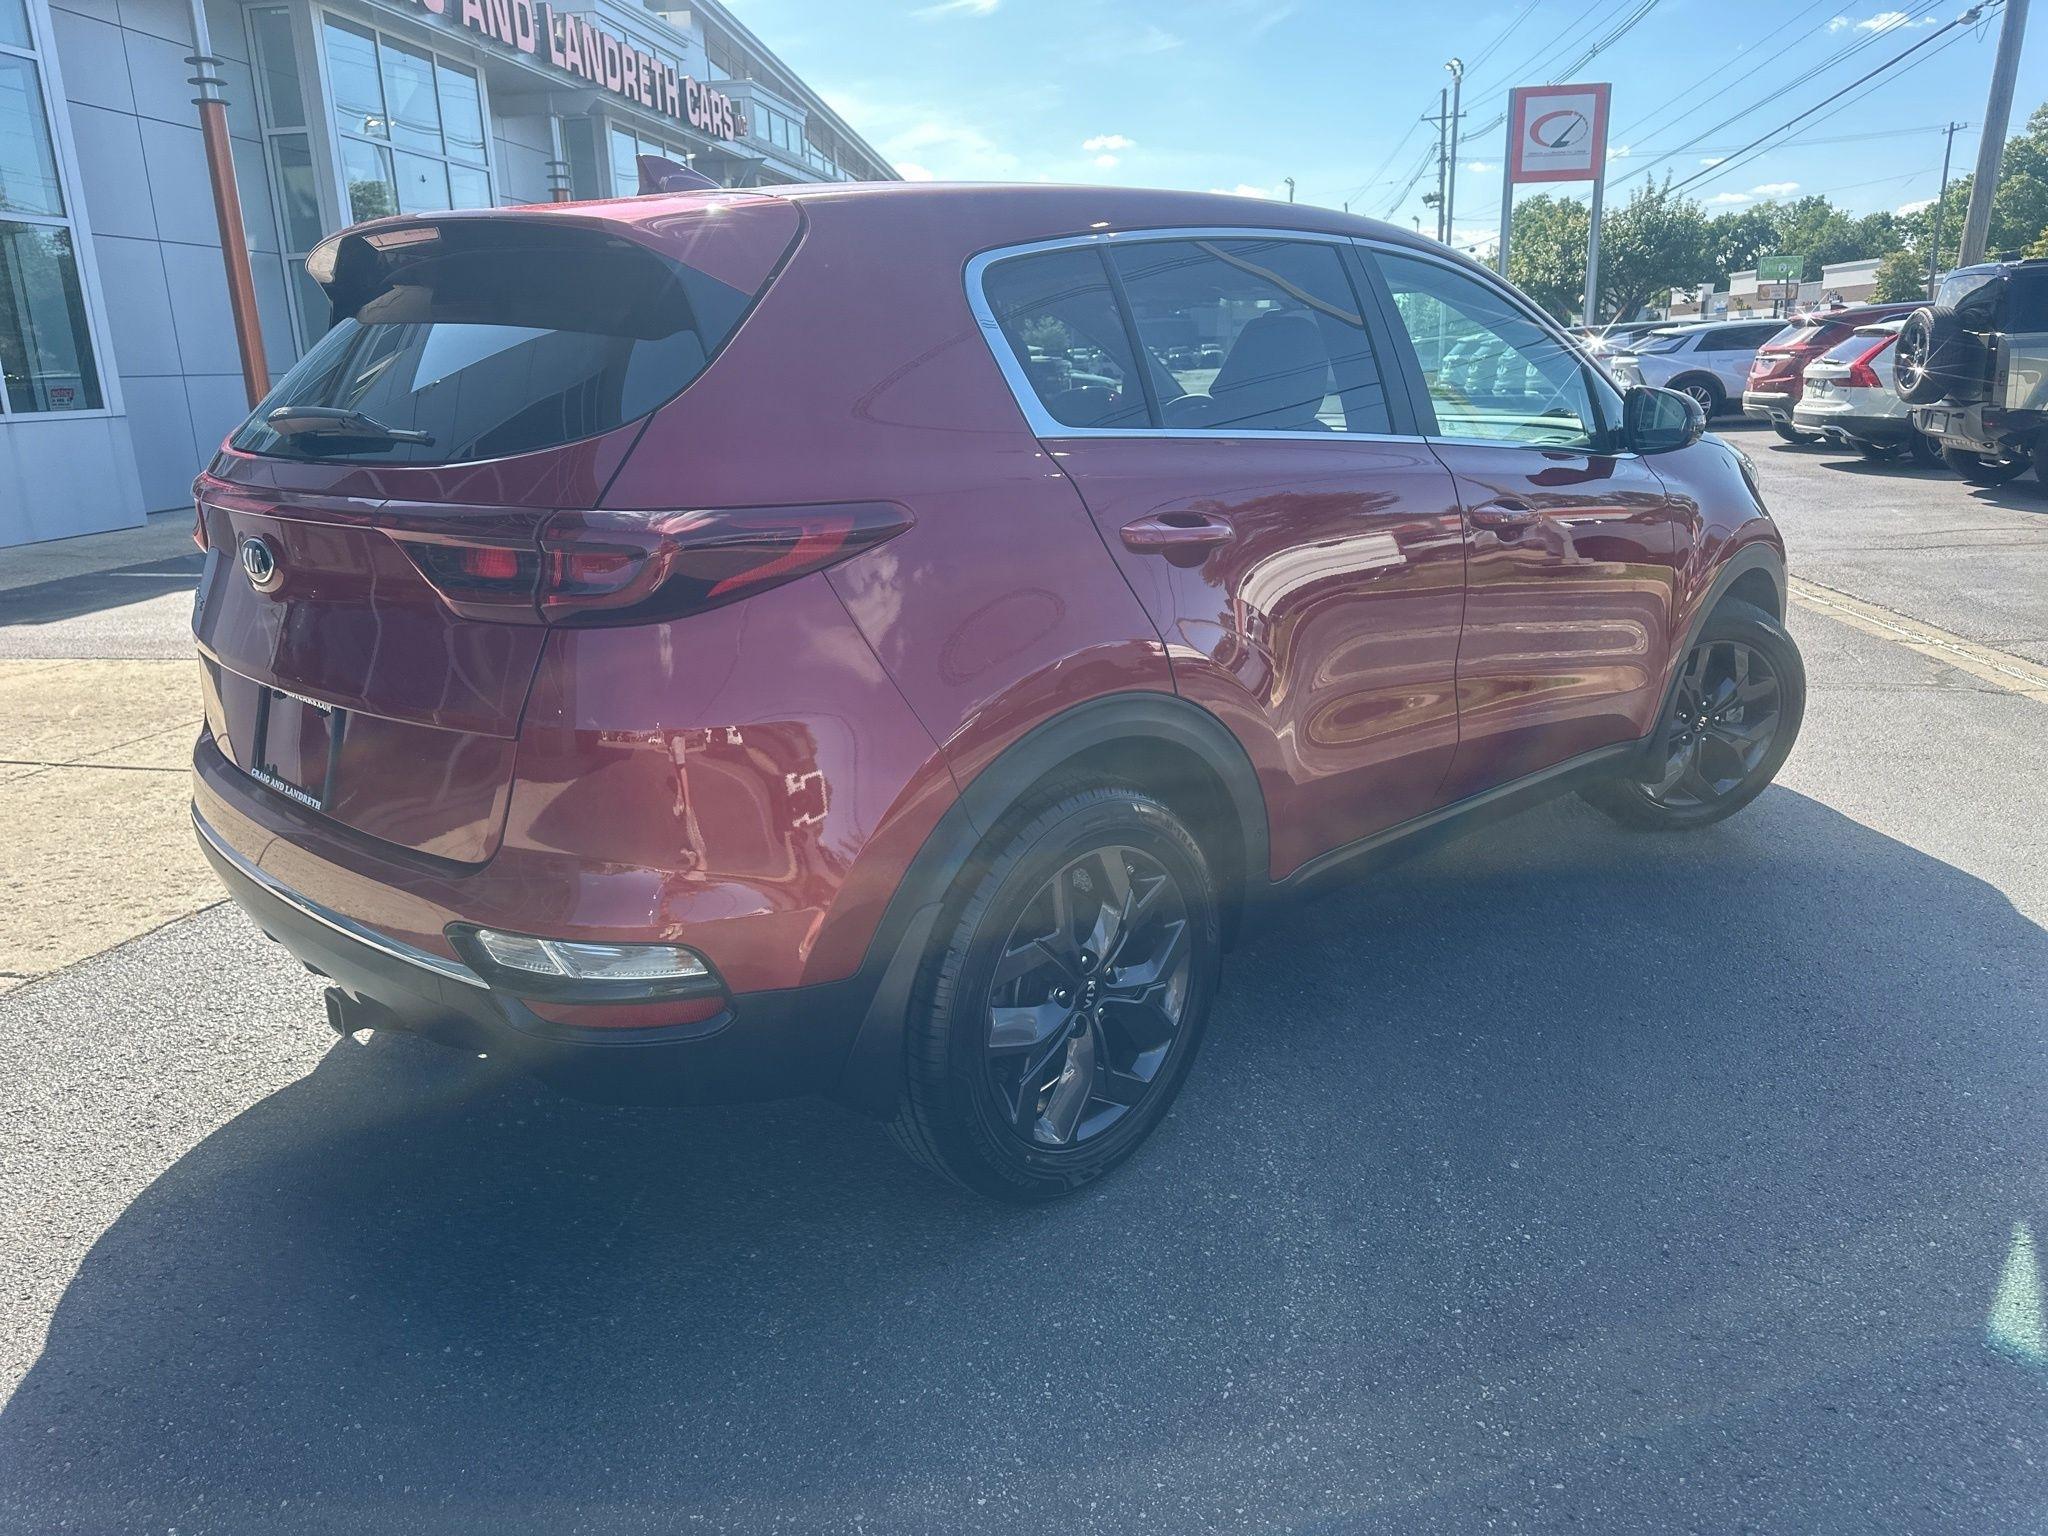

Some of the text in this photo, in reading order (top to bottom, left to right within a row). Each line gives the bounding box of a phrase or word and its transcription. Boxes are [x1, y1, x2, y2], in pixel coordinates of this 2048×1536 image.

[462, 0, 536, 54] AND
[546, 3, 680, 119] LANDRETH
[686, 75, 735, 142] CARS
[1695, 716, 1708, 732] KIA
[251, 768, 322, 810] CRAIG AND LANDRETH
[1083, 980, 1096, 1009] KIA
